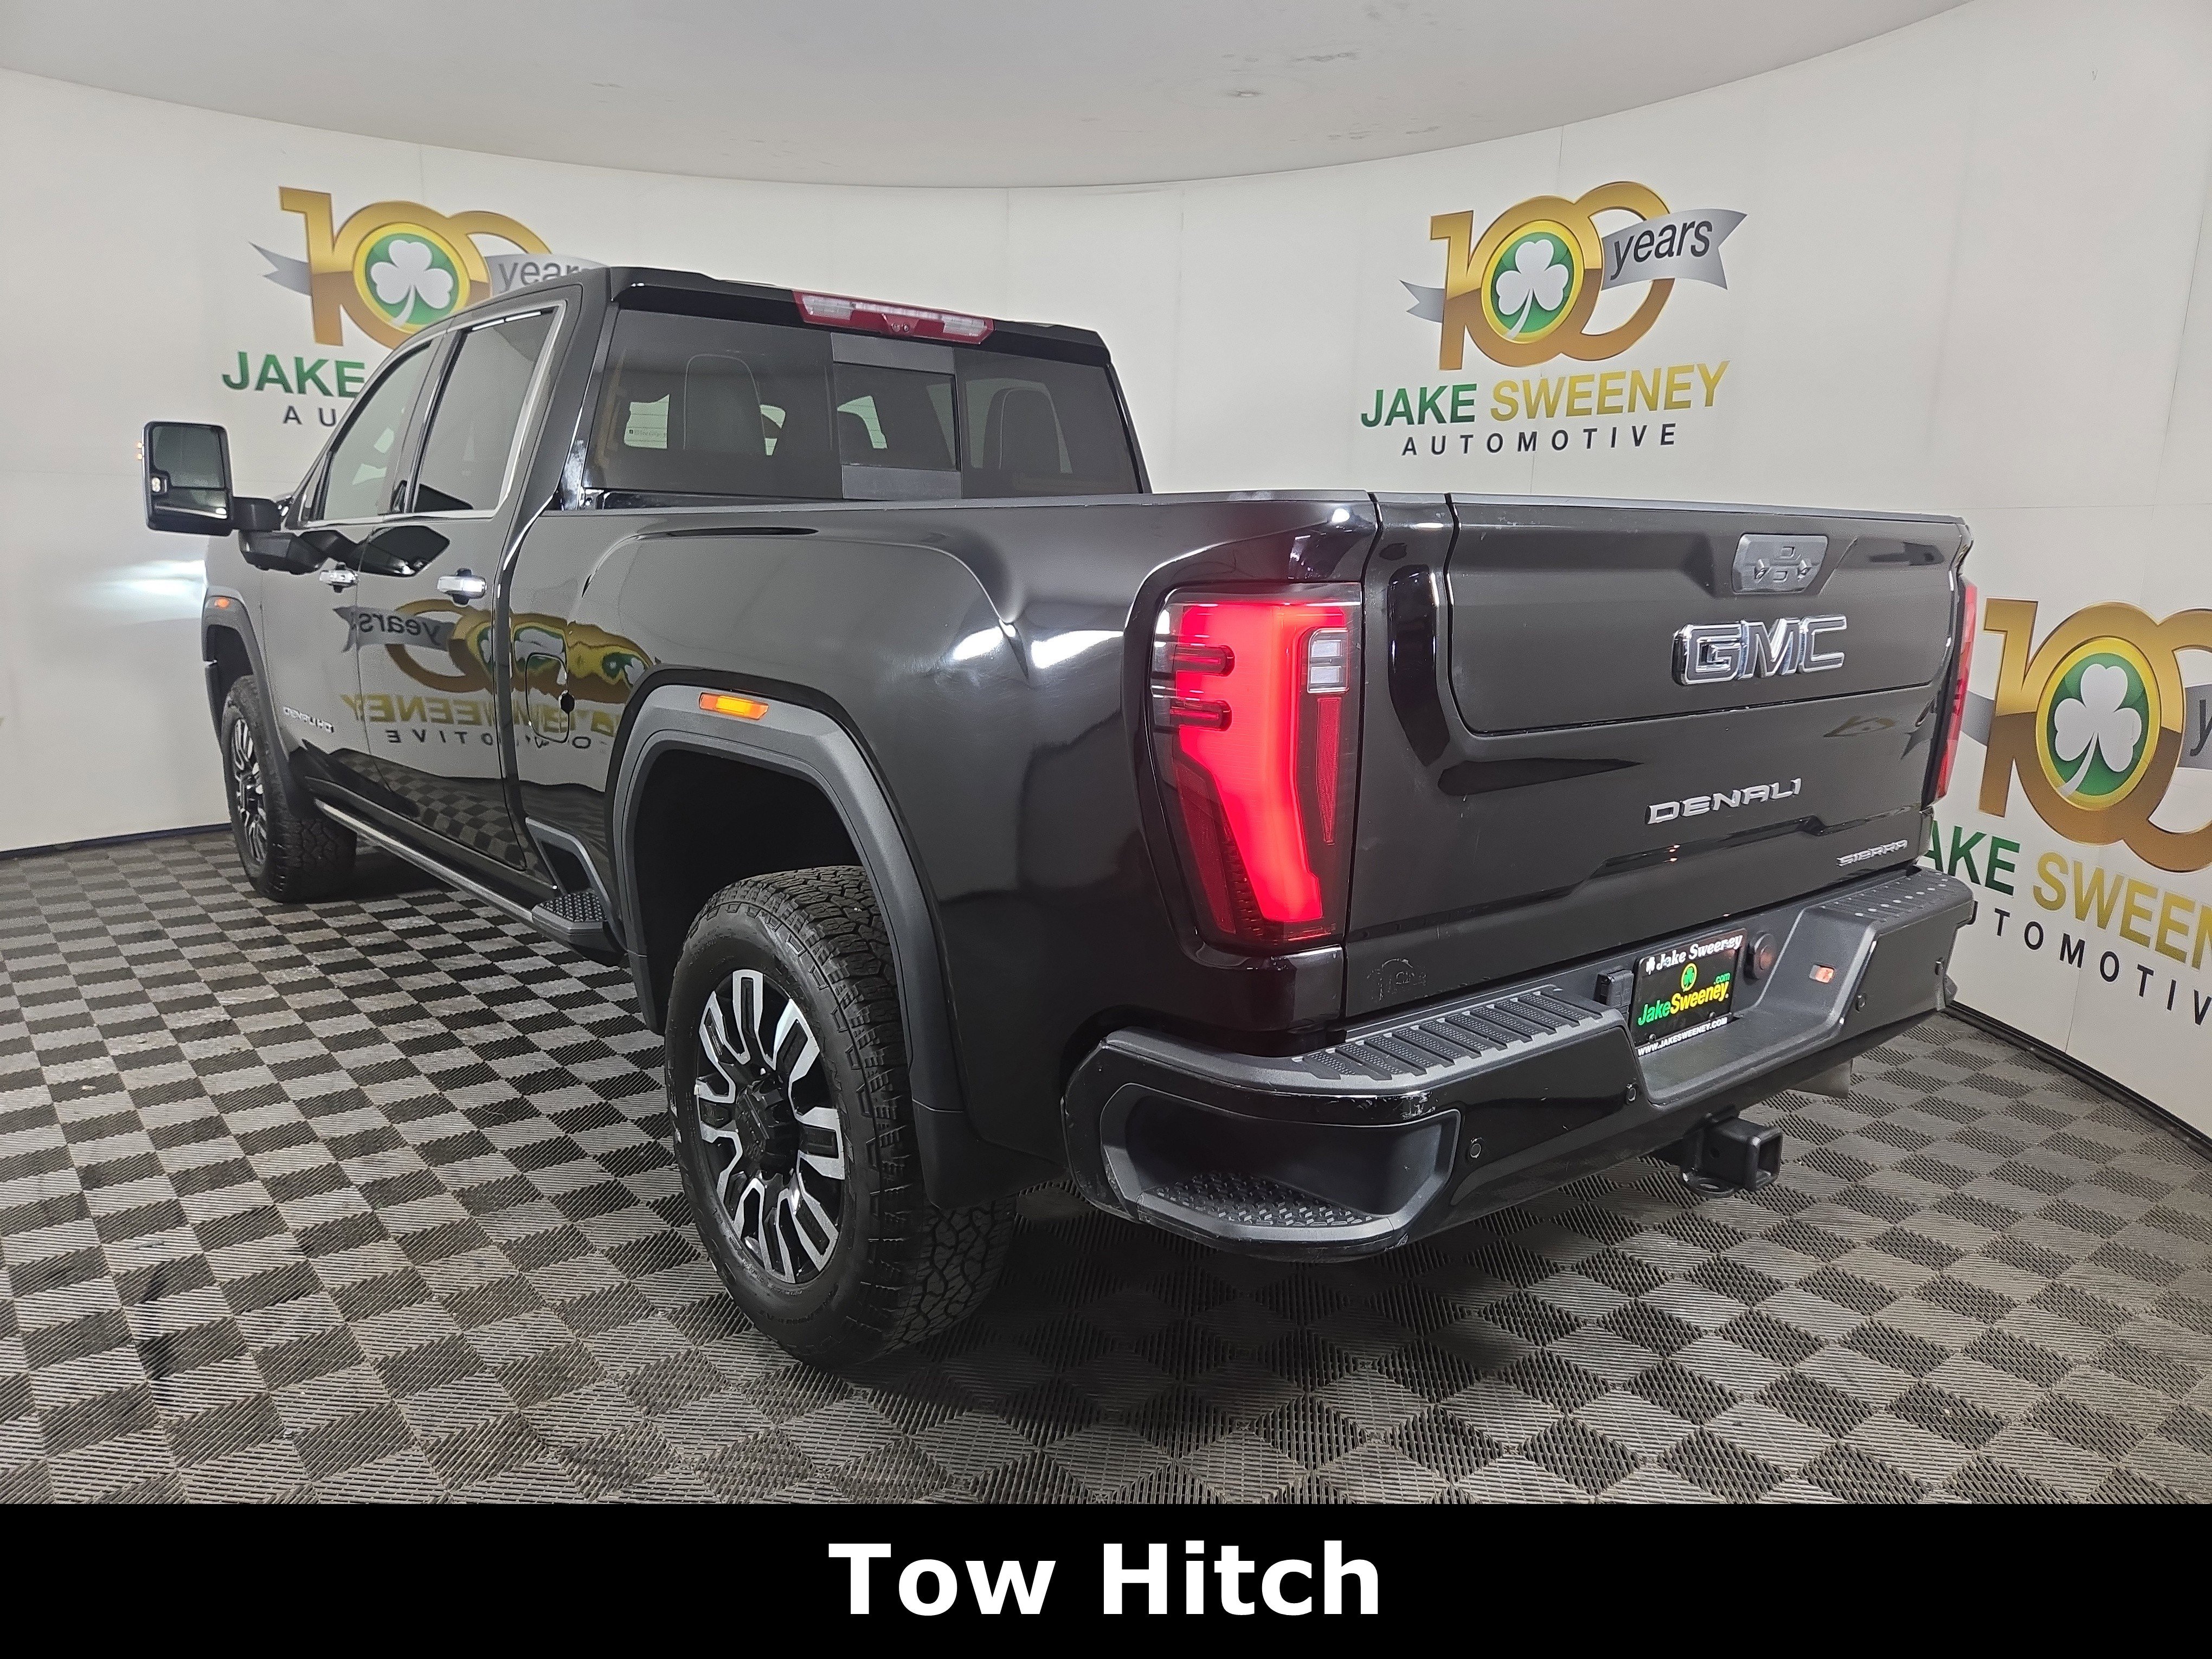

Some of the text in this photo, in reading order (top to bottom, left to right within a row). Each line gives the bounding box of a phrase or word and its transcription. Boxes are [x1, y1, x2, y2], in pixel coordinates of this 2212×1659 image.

[1610, 219, 1713, 281] years
[1430, 181, 1675, 371] 100
[222, 351, 366, 398] JAKE
[1361, 360, 1730, 428] JAKE SWEENEY
[1401, 423, 1676, 456] AUTOMOTIVE
[1672, 615, 1847, 685] GMC
[1645, 777, 1802, 825] DENALI
[1836, 839, 1908, 867] SIERRA
[1656, 949, 1687, 970] Jake
[1638, 1017, 1728, 1056] WWW.JAKESWEENEY.COM
